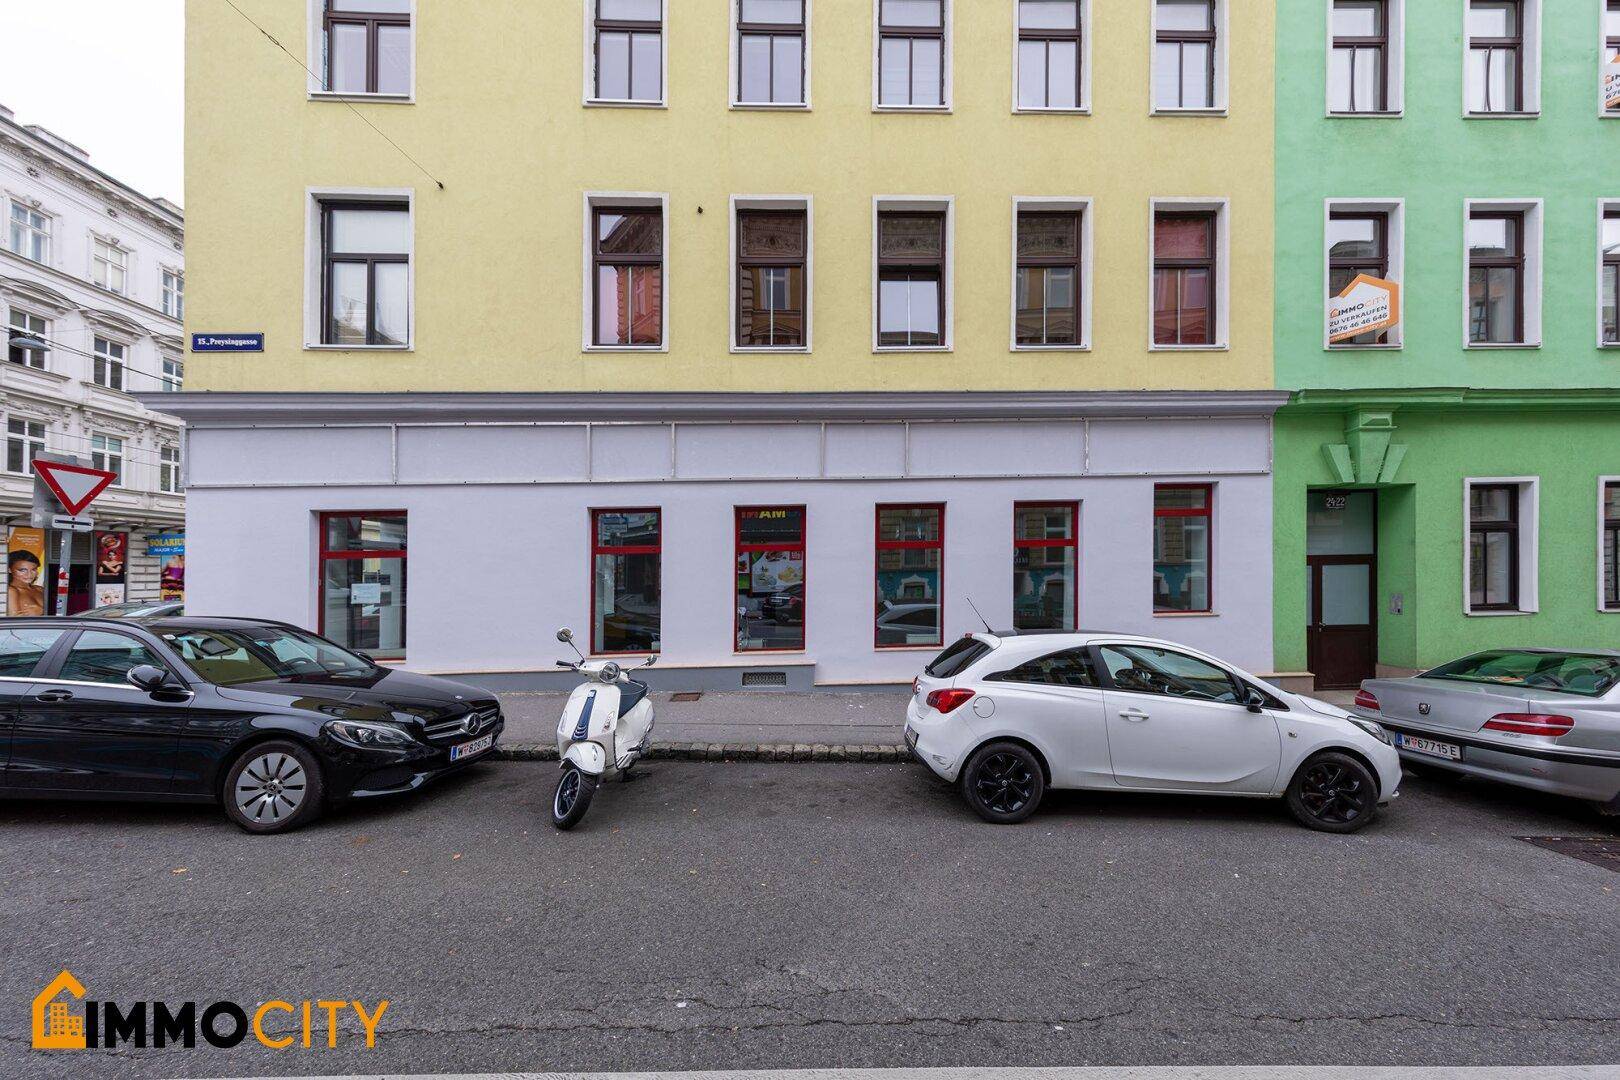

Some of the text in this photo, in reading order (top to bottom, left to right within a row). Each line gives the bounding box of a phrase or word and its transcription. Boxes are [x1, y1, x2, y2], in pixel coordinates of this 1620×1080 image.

[1338, 295, 1387, 316] IMMOCITY
[1341, 305, 1387, 322] VERKAUFEN
[1329, 325, 1348, 334] 0676
[1361, 317, 1371, 325] 46
[1372, 312, 1388, 321] 646
[149, 538, 185, 547] SOLARIU
